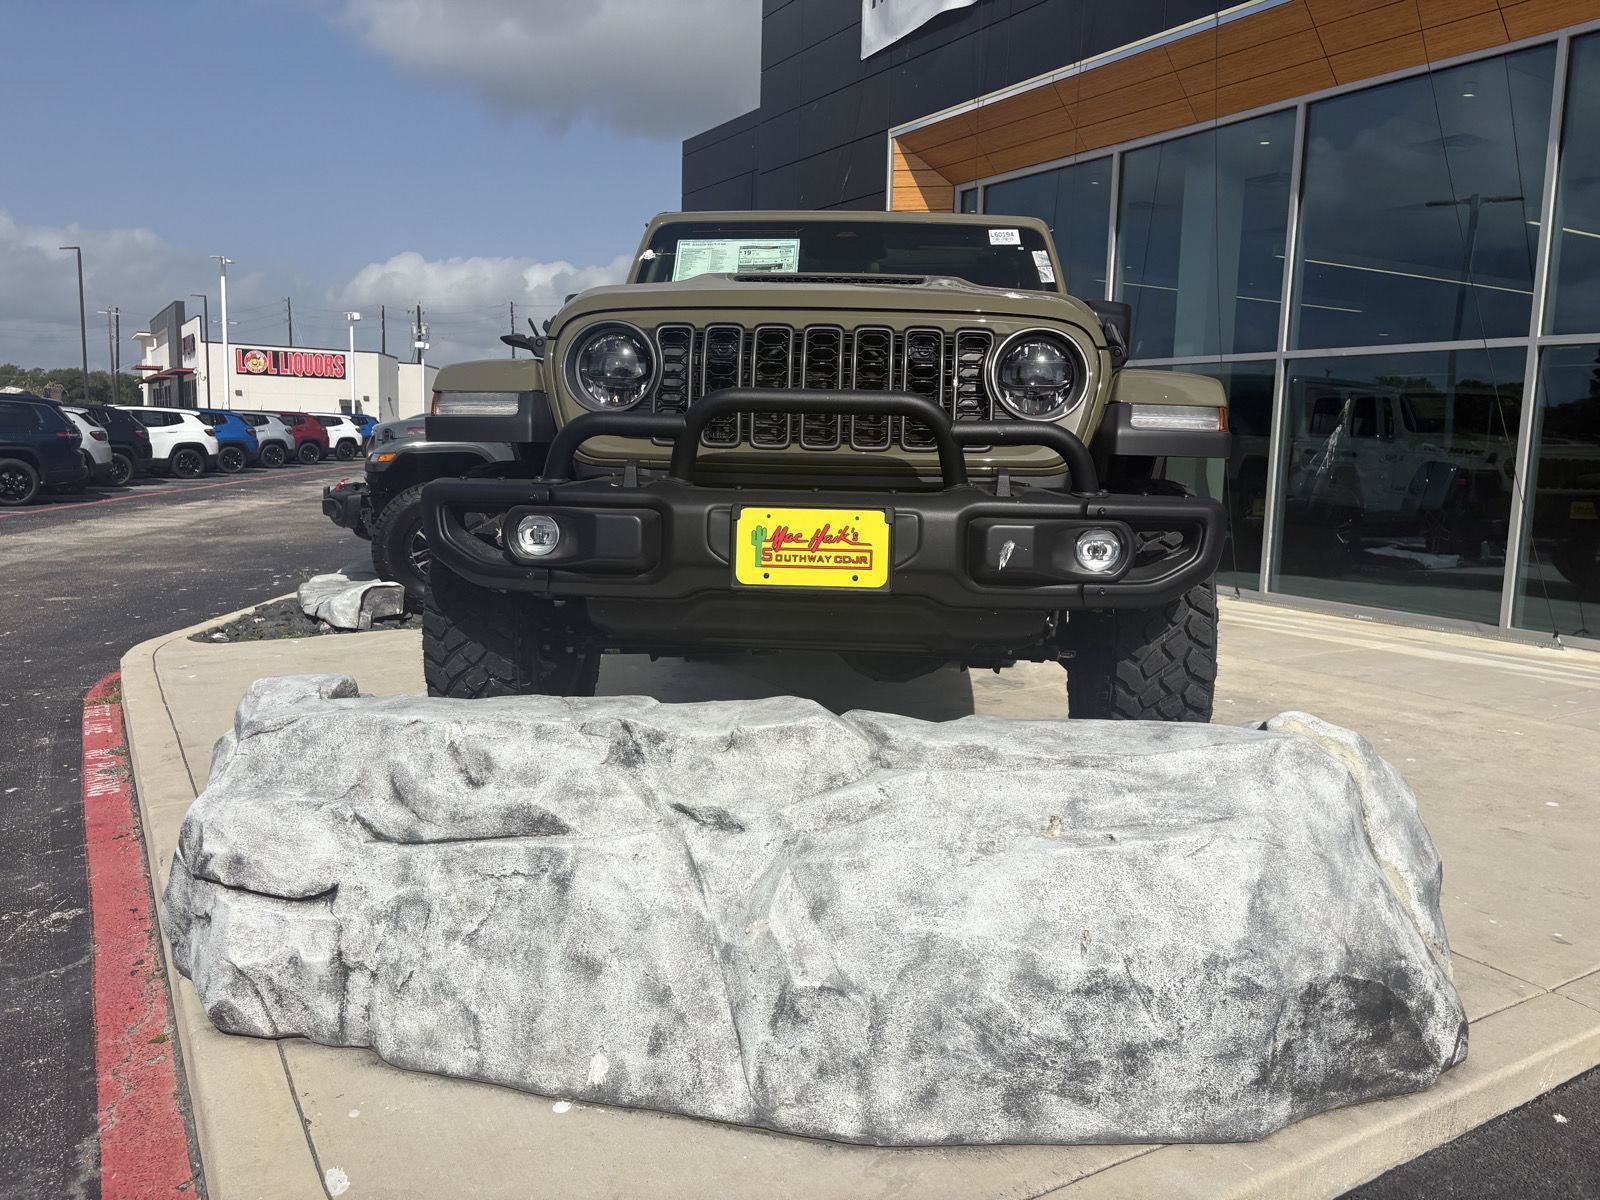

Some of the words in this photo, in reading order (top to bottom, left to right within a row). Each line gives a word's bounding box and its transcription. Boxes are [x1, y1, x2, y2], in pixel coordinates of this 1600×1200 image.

[279, 351, 345, 378] LIQUORS
[765, 525, 808, 553] Mac
[761, 547, 832, 564] SOUTHWAY
